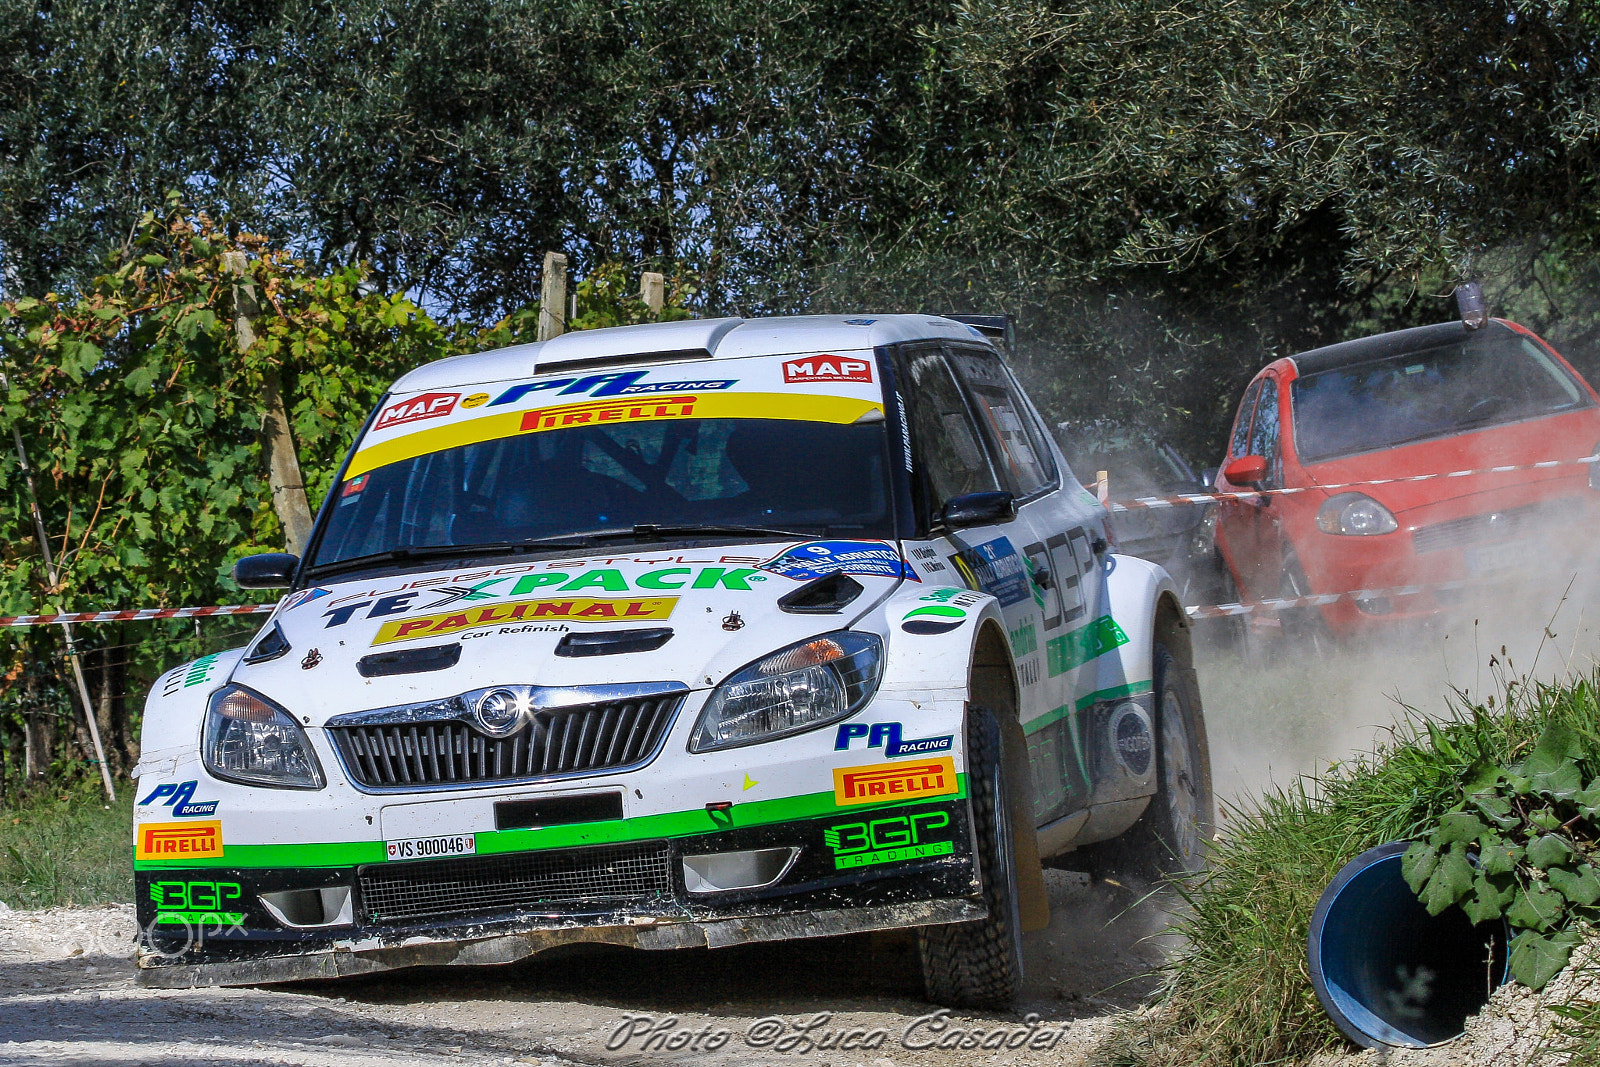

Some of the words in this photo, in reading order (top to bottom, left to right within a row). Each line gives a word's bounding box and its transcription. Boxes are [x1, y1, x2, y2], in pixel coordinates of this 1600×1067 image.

[787, 361, 866, 377] MAP
[620, 381, 726, 394] RACING
[379, 396, 456, 424] MAP
[519, 396, 698, 431] PIRELLI
[790, 557, 834, 569] RALLY
[834, 550, 901, 562] ADRIATICO
[806, 546, 831, 555] 9
[461, 631, 493, 640] Car
[498, 624, 570, 635] Refinish
[834, 722, 903, 757] PA
[898, 738, 949, 753] RACING
[843, 764, 944, 798] PIRELLI
[138, 780, 198, 813] PA
[181, 804, 215, 814] RACING
[145, 827, 215, 853] PIRELLI
[398, 842, 413, 857] VS
[417, 837, 464, 856] 900046
[839, 844, 942, 867] TRADING
[162, 913, 240, 923] TRADING
